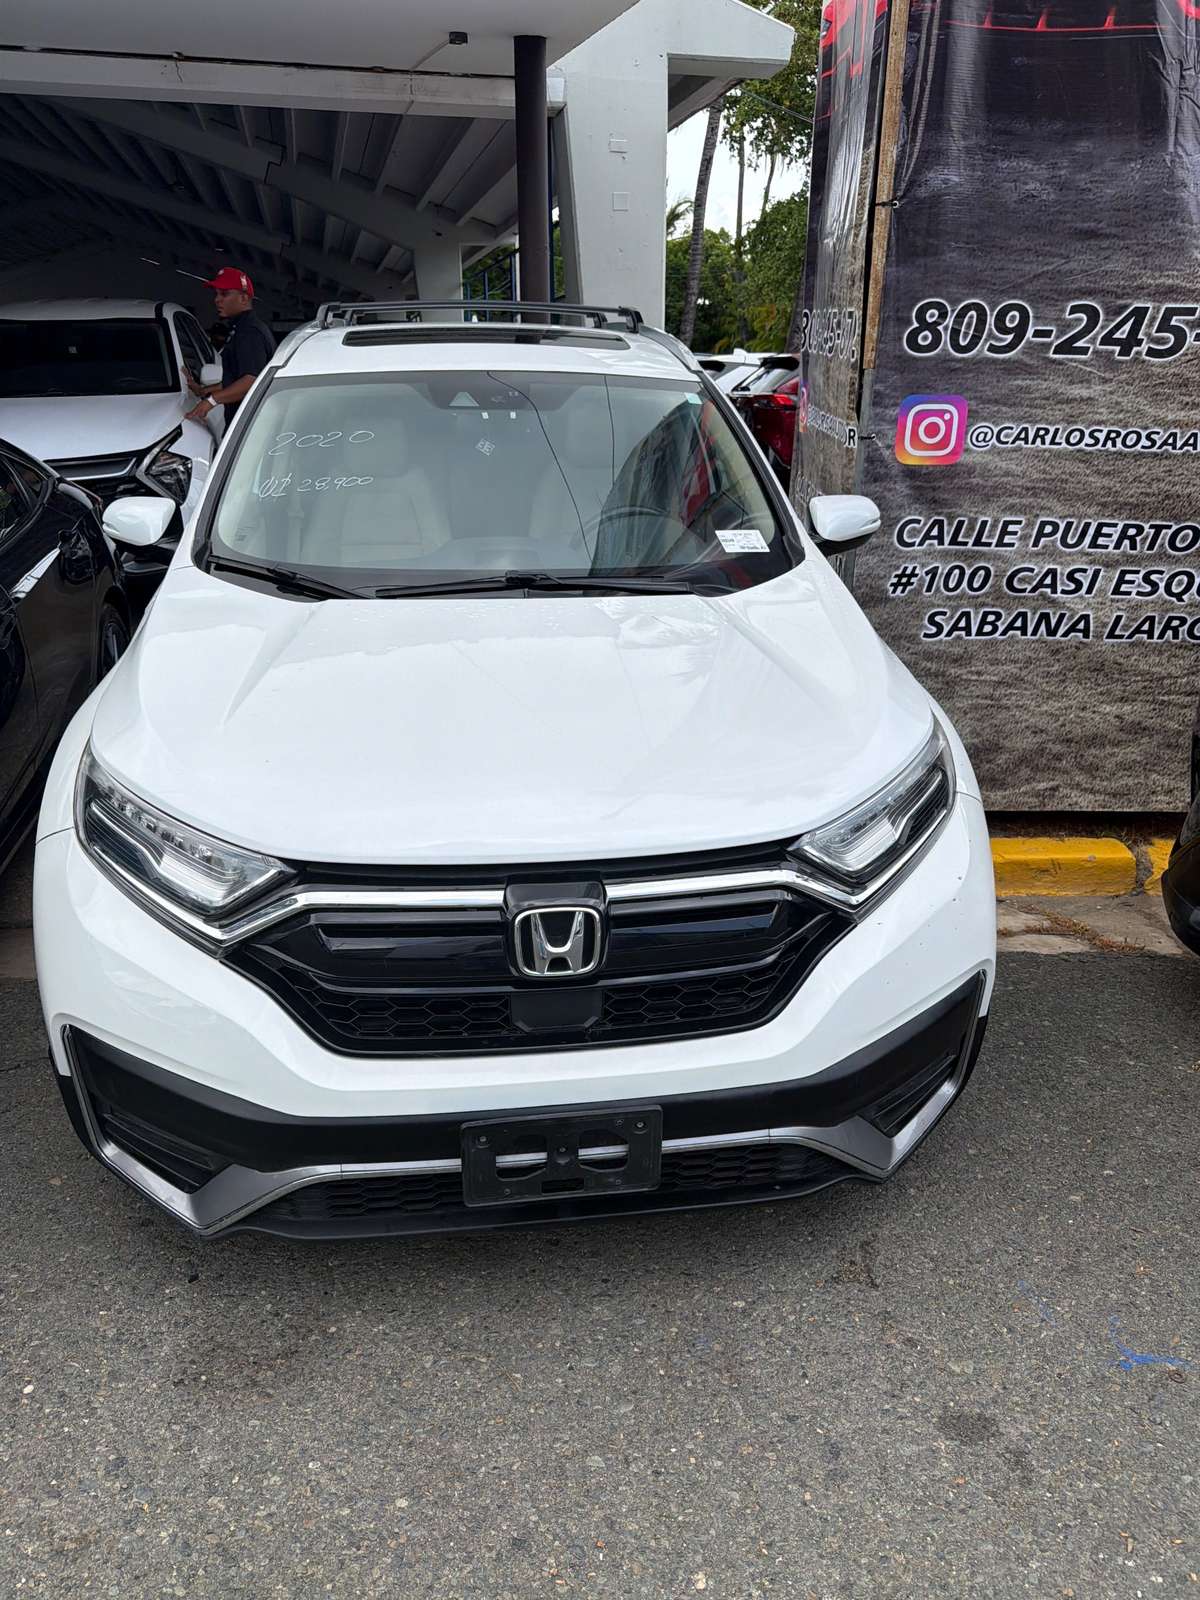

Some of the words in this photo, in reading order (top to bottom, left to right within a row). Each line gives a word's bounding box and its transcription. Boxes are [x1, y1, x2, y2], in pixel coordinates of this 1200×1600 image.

[267, 430, 375, 456] 2020
[969, 425, 1199, 451] @CARLOSROSAA
[896, 517, 1023, 549] CALLE
[1032, 520, 1200, 553] PUERTO
[889, 564, 992, 595] #100
[1004, 567, 1102, 597] CASI
[1110, 568, 1200, 603] ESQ
[922, 610, 1091, 640] SABANA
